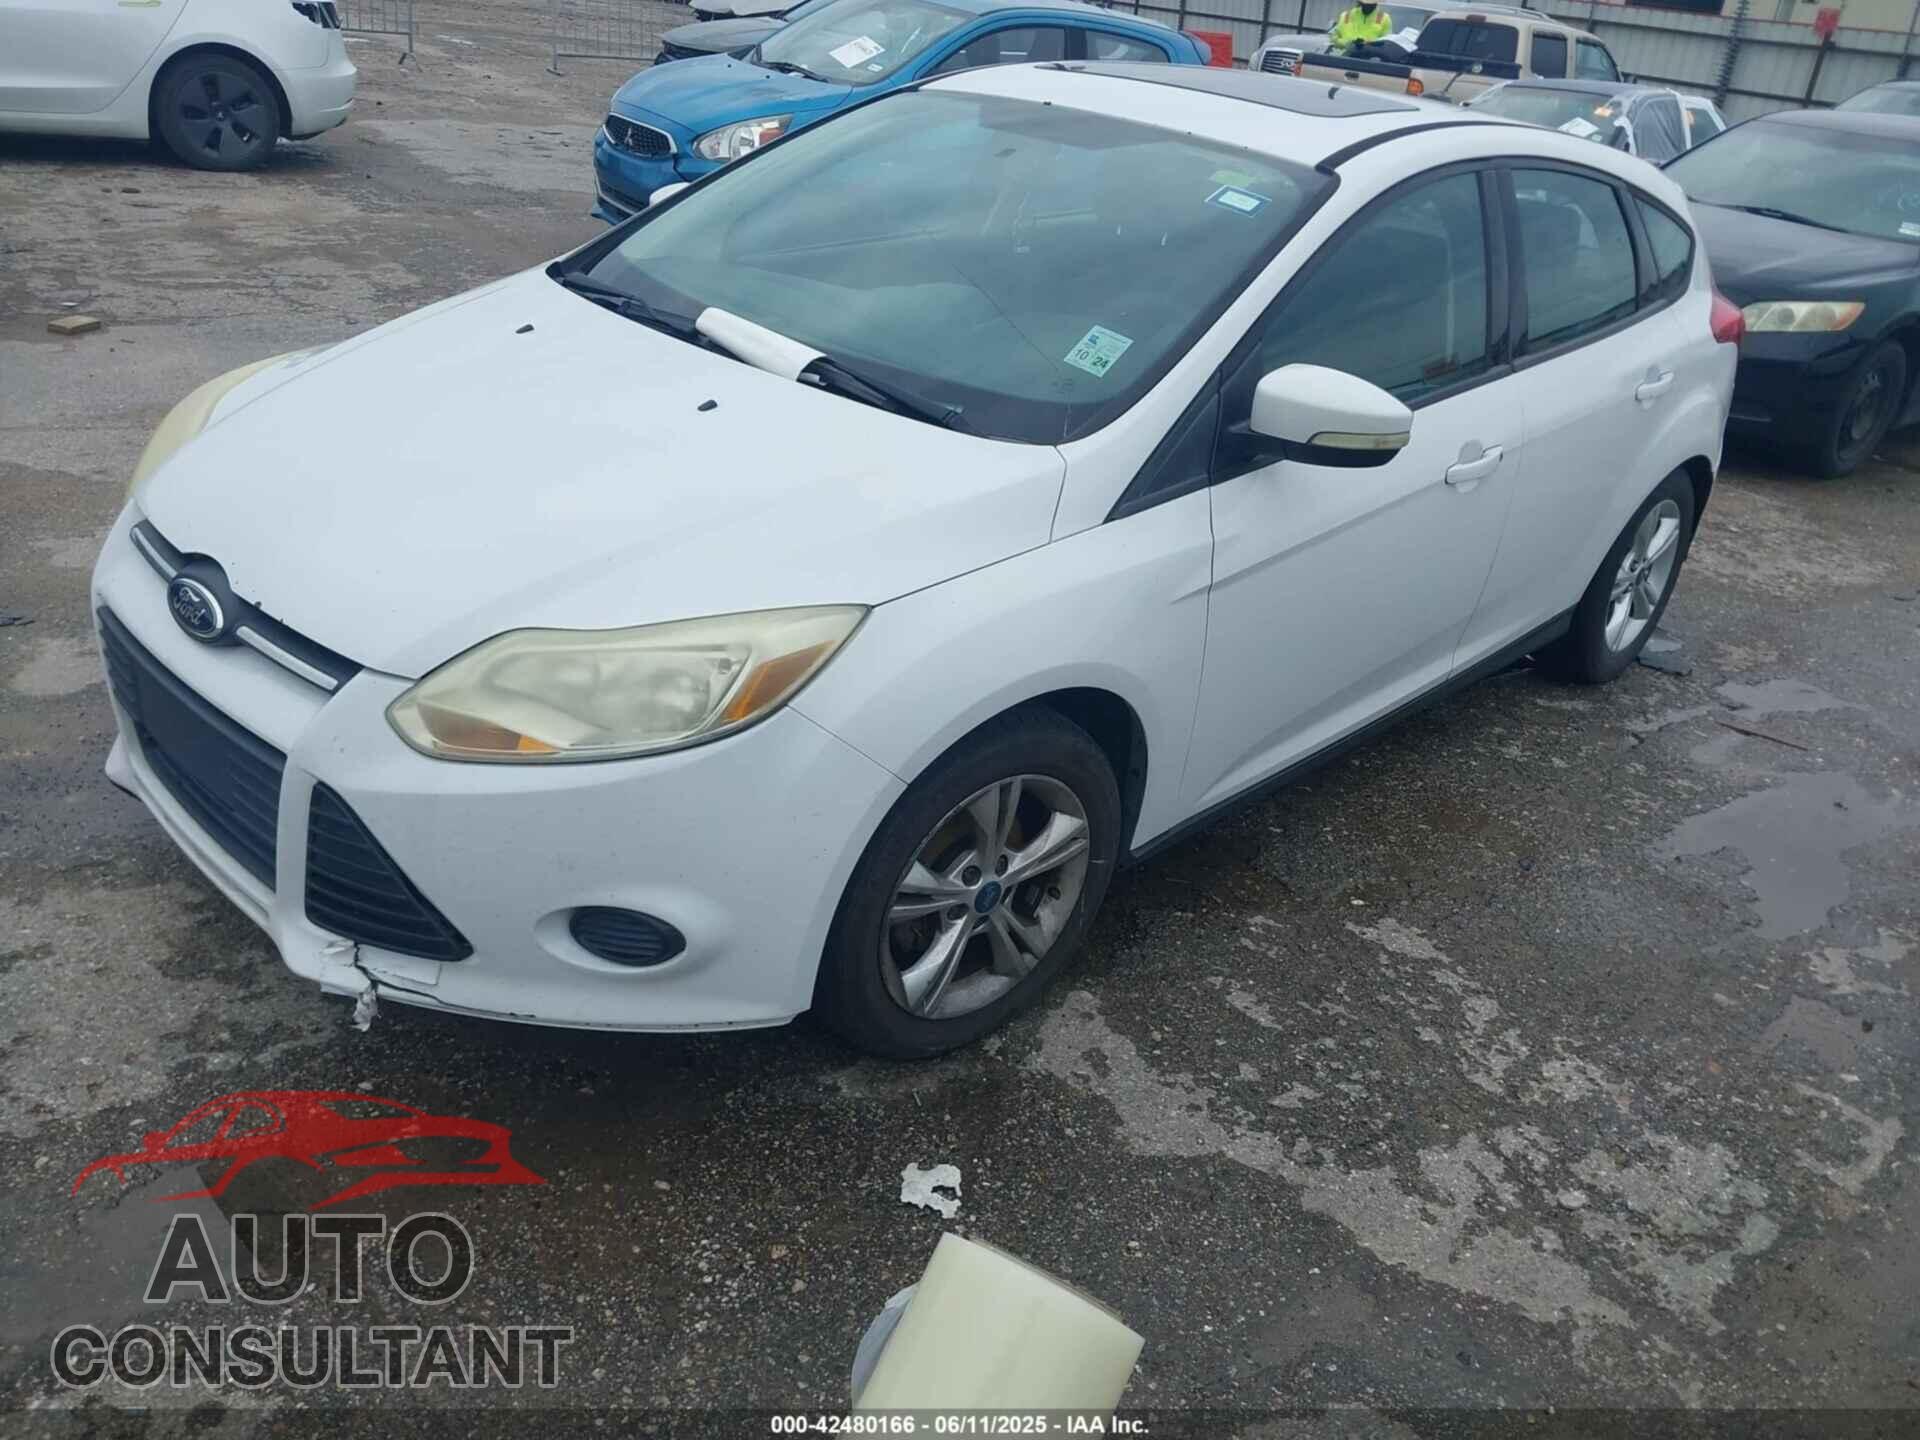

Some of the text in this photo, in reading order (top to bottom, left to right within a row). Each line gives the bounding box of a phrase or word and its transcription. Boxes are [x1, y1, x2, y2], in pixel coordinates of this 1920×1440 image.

[1073, 348, 1108, 369] 10 24
[173, 586, 206, 625] Ford
